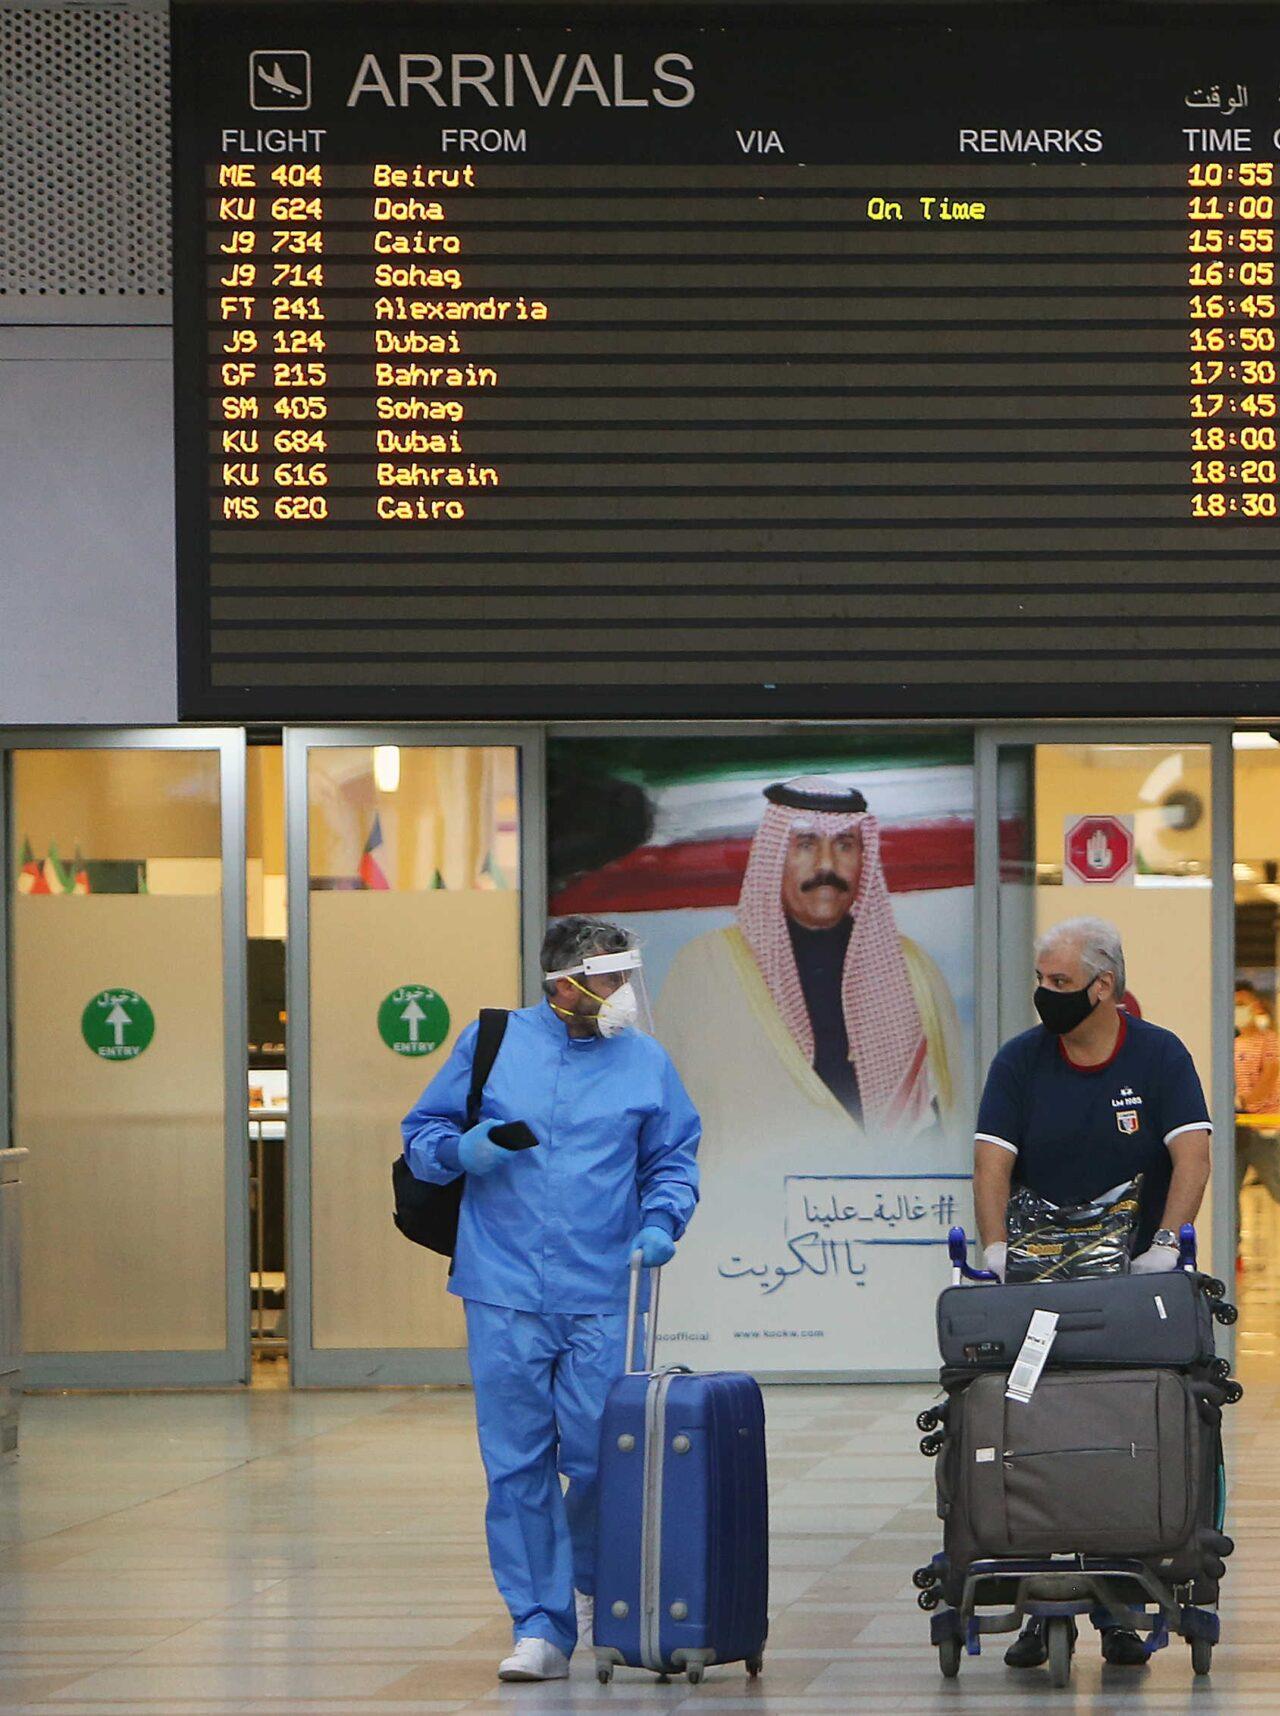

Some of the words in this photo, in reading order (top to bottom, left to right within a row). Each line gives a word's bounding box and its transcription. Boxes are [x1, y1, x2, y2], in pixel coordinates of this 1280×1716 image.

[347, 53, 695, 108] ARRIVALS
[1184, 84, 1248, 116] الوقت
[222, 129, 327, 153] FLIGHT
[442, 128, 526, 152] FROM
[735, 130, 785, 154] VIA
[959, 128, 1103, 153] REMARKS
[1182, 128, 1252, 152] TIME
[219, 164, 256, 187] ME
[271, 164, 323, 187] 404
[373, 164, 475, 188] Beirut
[1187, 162, 1274, 187] 10:55
[219, 197, 256, 221] KU
[271, 197, 323, 221] 624
[373, 197, 445, 221] Doha
[867, 197, 903, 220] On
[919, 197, 986, 220] Time
[1187, 195, 1274, 220] 11:00
[220, 230, 256, 254] J9
[271, 230, 324, 254] 734
[374, 230, 461, 254] Cairo
[1188, 228, 1274, 253] 15:55
[220, 263, 256, 287] J9
[271, 263, 324, 287] 714
[374, 263, 463, 290] Sohag
[1188, 261, 1275, 286] 16:05
[220, 296, 256, 320] FT
[272, 296, 325, 320] 241
[374, 296, 548, 320] Alexandria
[1189, 294, 1276, 319] 16:45
[223, 330, 258, 353] J9
[272, 329, 327, 354] 124
[375, 329, 461, 354] Dubai
[1189, 327, 1276, 352] 16:50
[221, 362, 257, 386] GF
[273, 362, 327, 387] 215
[375, 362, 497, 387] Bahrain
[1189, 360, 1276, 385] 17:30
[221, 396, 259, 420] SM
[273, 396, 328, 420] 405
[376, 396, 464, 422] Sohag
[1189, 393, 1277, 418] 17:45
[222, 429, 259, 453] KU
[273, 429, 328, 453] 684
[376, 429, 463, 453] Dubai
[1190, 427, 1277, 451] 18:00
[222, 463, 260, 486] KU
[274, 463, 328, 486] 616
[376, 462, 499, 486] Bahrain
[1190, 460, 1277, 484] 18:20
[223, 496, 260, 520] MS
[274, 496, 328, 520] 620
[377, 496, 465, 520] Cairo
[1190, 493, 1277, 517] 18:30
[98, 1045, 141, 1057] ENTRY
[393, 1041, 436, 1052] ENTRY
[717, 1231, 839, 1295] الكويت
